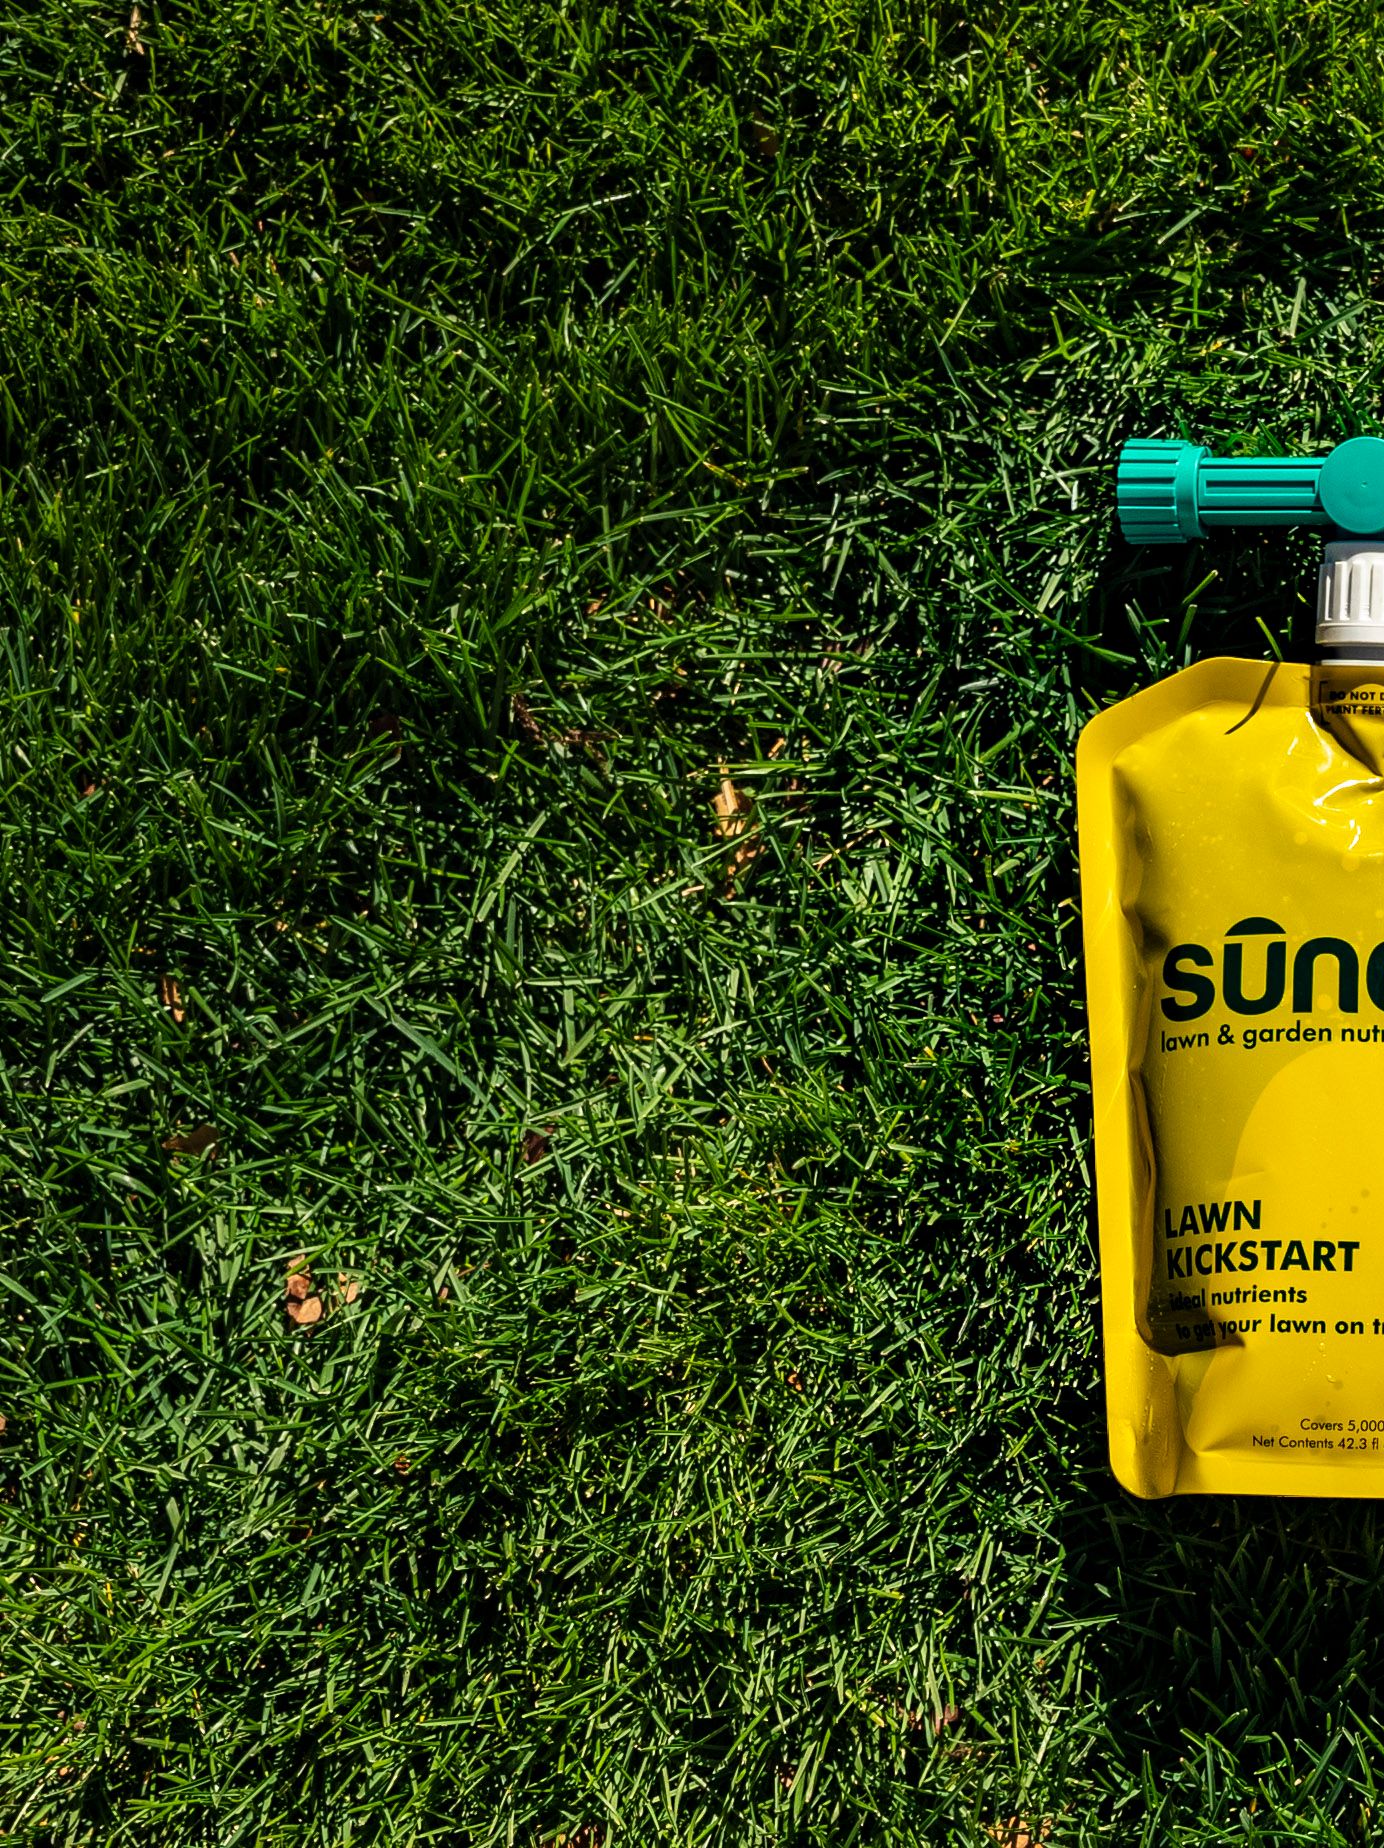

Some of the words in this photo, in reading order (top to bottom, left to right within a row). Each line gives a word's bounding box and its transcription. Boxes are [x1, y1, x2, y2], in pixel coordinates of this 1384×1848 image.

[1349, 691, 1376, 702] NOT
[1161, 1030, 1210, 1054] lawn
[1216, 1024, 1235, 1046] &
[1242, 1020, 1332, 1050] garden
[1164, 1199, 1262, 1239] LAWN
[1166, 1239, 1360, 1280] KICKSTART
[1168, 1288, 1206, 1312] ideal
[1211, 1284, 1308, 1306] nutrients
[1175, 1323, 1191, 1341] to
[1193, 1319, 1216, 1342] get
[1217, 1318, 1262, 1340] your
[1269, 1313, 1326, 1334] lawn
[1334, 1319, 1365, 1335] on
[1300, 1418, 1343, 1432] Covers
[1252, 1435, 1275, 1448] Net
[1278, 1435, 1334, 1449] Contents
[1337, 1437, 1367, 1450] 42.3
[1371, 1437, 1379, 1450] fl
